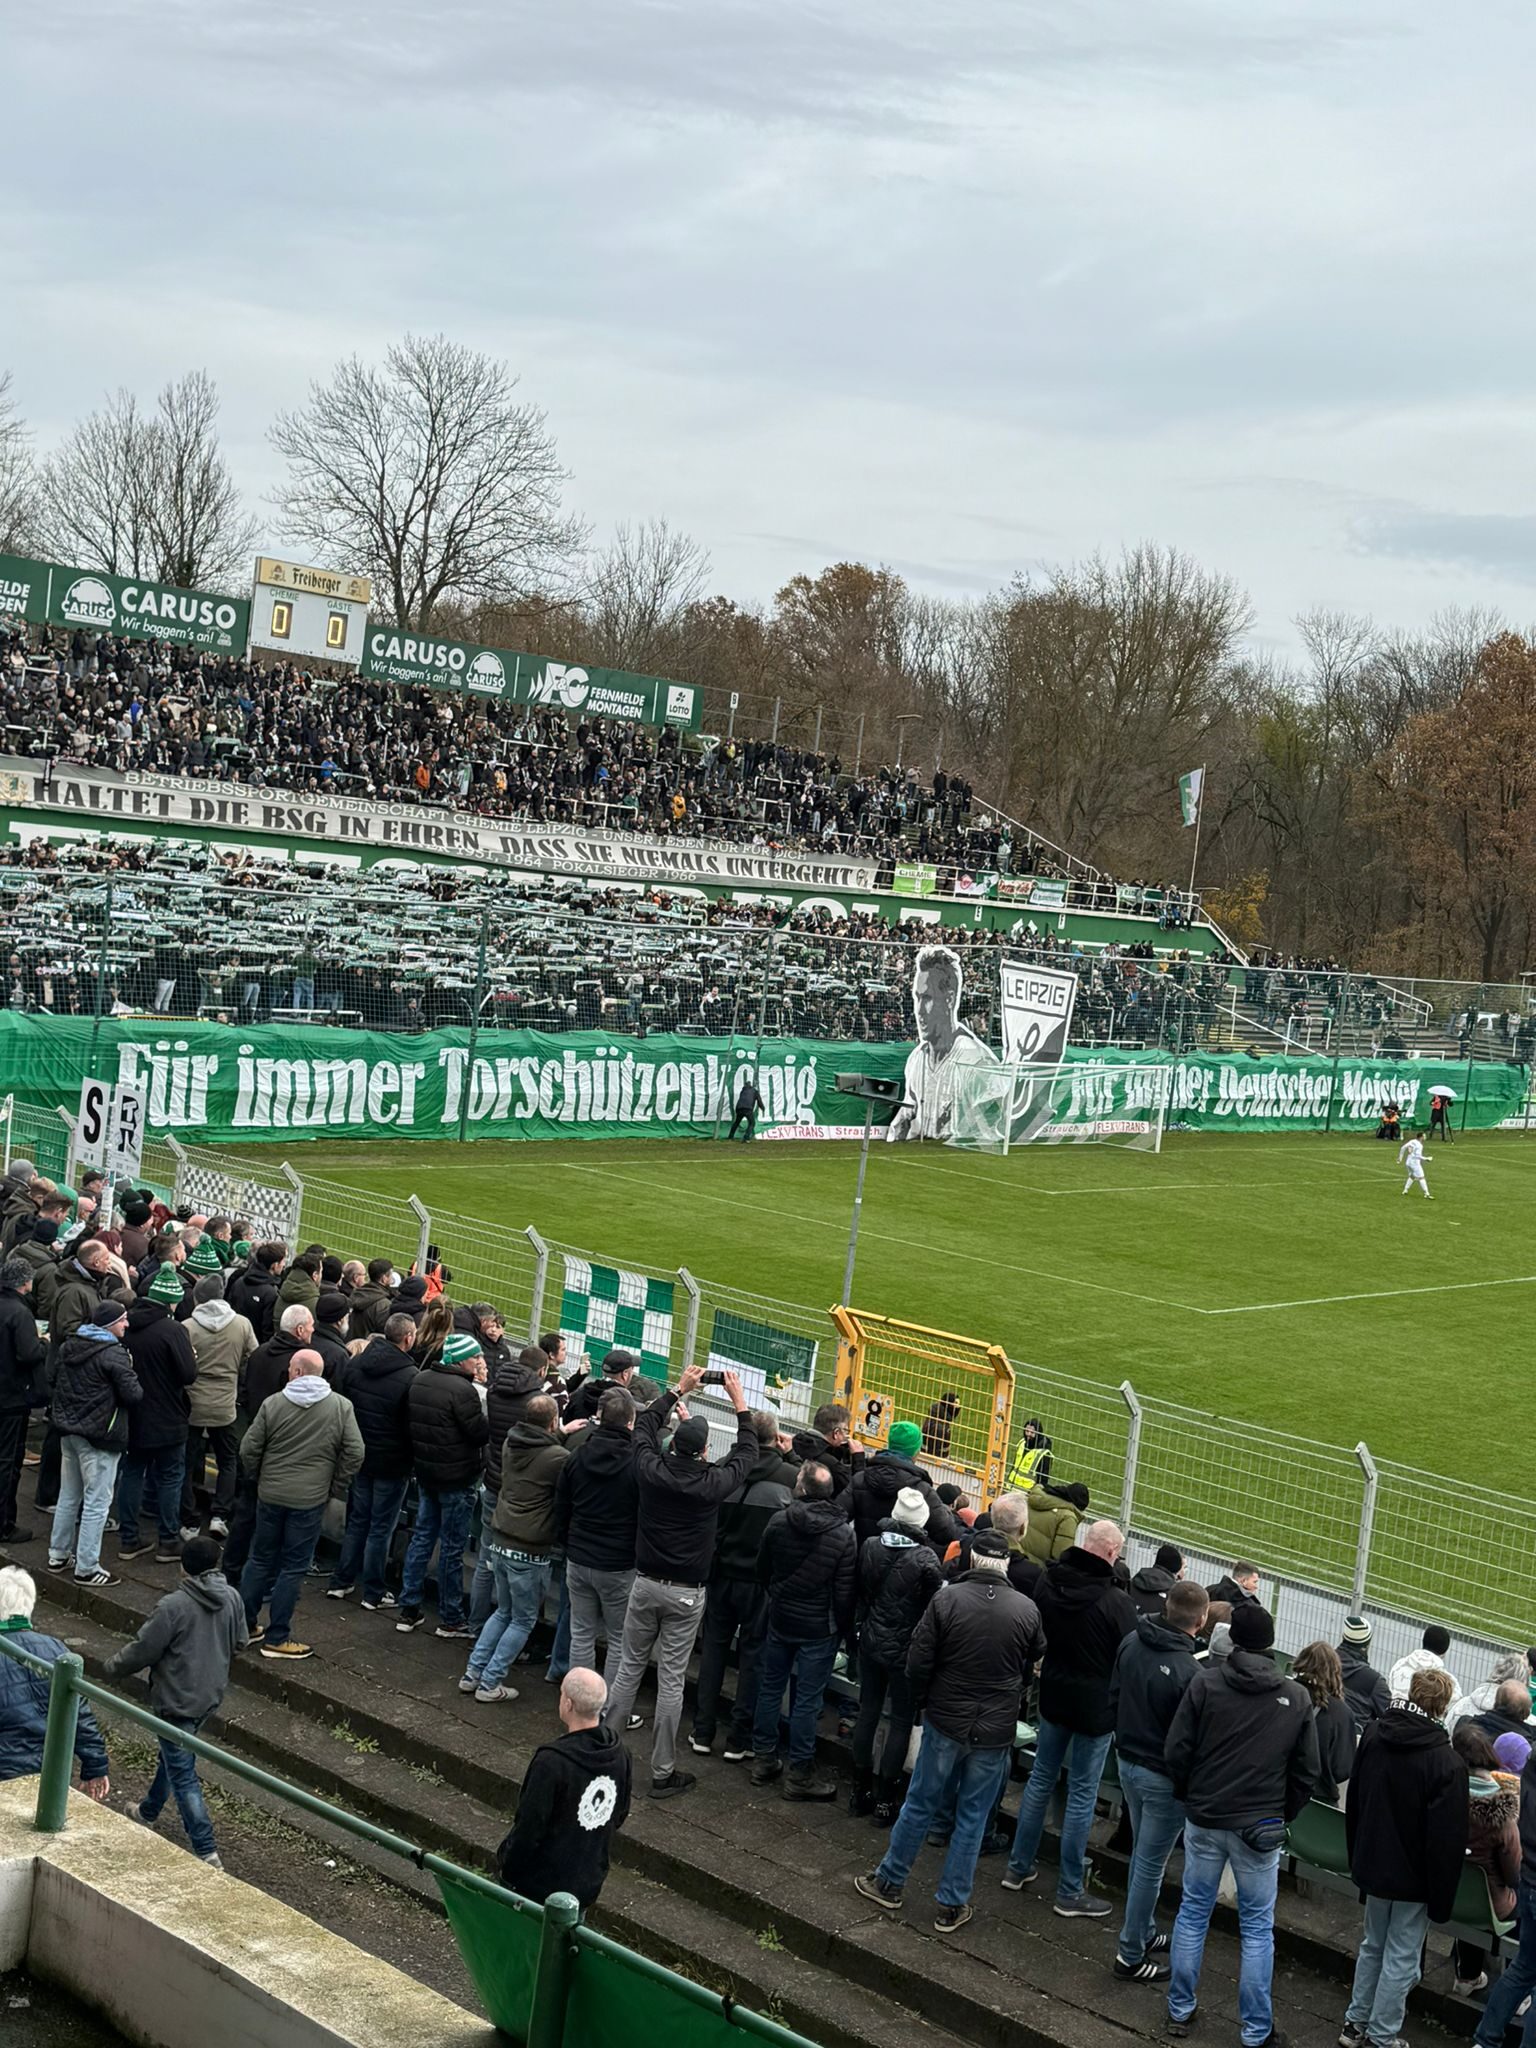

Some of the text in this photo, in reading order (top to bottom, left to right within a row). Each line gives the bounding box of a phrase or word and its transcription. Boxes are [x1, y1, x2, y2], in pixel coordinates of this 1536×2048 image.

[269, 588, 300, 602] CHEMIE
[292, 567, 342, 594] Freiberger
[61, 600, 117, 620] CARUSO
[121, 586, 237, 629] CARUSO
[272, 604, 288, 634] 0
[120, 615, 141, 631] Wir
[143, 618, 194, 640] baggern's
[196, 631, 214, 644] an!
[327, 616, 343, 645] 0
[371, 633, 466, 670] CARUSO
[370, 659, 387, 673] Wir
[432, 673, 447, 684] an!
[465, 672, 506, 688] CARUSO
[586, 699, 642, 719] MONTAGEN
[590, 686, 645, 706] FERNMELDE
[668, 704, 690, 715] LOTTO
[124, 770, 449, 821] BETRIEBSSPORTGEMEINSCHAFT
[453, 814, 522, 834] CHEMIE
[526, 822, 587, 838] LEIPZIG
[603, 830, 653, 846] UNSER
[708, 842, 738, 853] NUR
[33, 777, 175, 816] HALTET
[189, 797, 250, 825] DIE
[262, 804, 328, 834] BSG
[339, 814, 371, 838] IN
[498, 836, 570, 860] DASS
[573, 841, 616, 864] SIE
[620, 846, 720, 875] NIEMALS
[726, 857, 854, 886] UNTERGEHT
[506, 853, 543, 868] 1964
[552, 861, 660, 879] POKALSIEGER
[663, 870, 697, 881] 1966
[1006, 976, 1066, 1007] LEIPZIG
[117, 1040, 817, 1127] Für immer Torschützenkönig
[1213, 1065, 1339, 1119] Deutscher
[1339, 1069, 1421, 1119] Meister
[83, 1086, 104, 1145] S
[865, 1399, 882, 1428] 8
